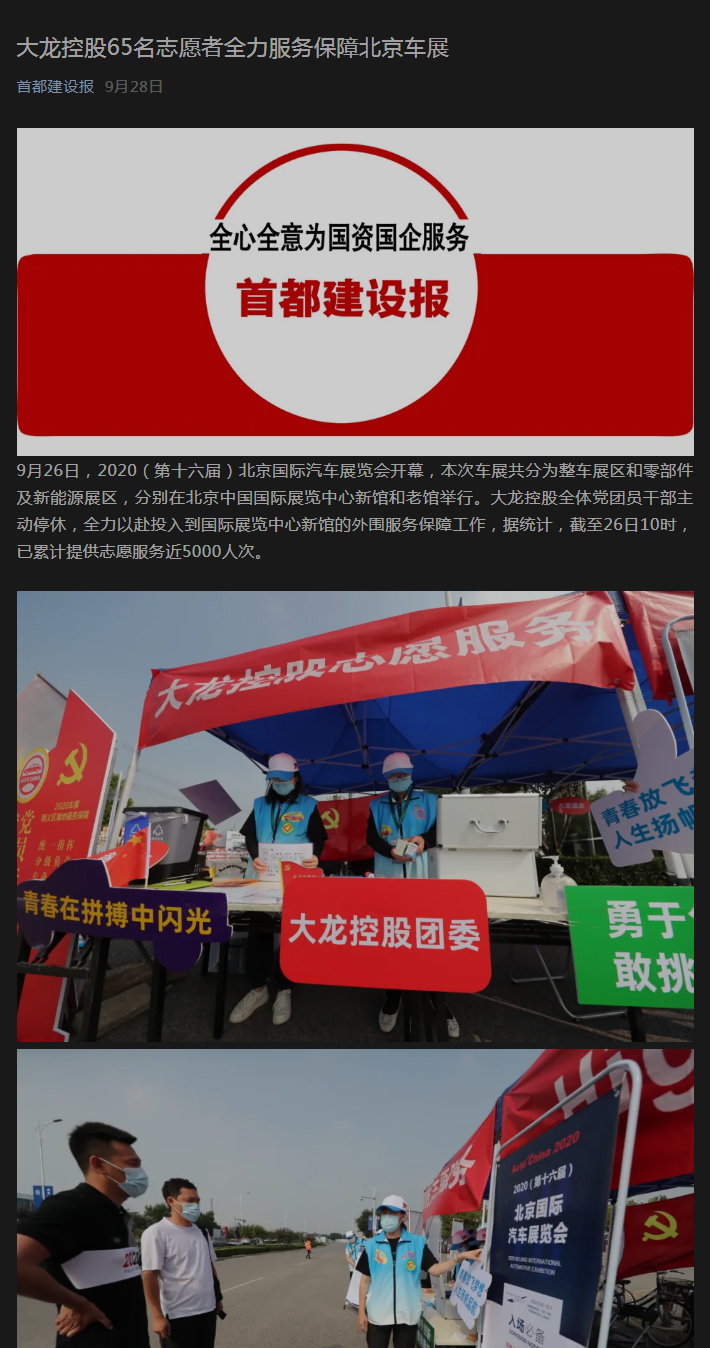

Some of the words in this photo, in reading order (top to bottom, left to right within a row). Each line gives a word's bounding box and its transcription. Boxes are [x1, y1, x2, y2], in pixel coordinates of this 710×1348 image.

[16, 36, 449, 59] 大龙控股65名志愿者全力服务保障北京车展
[16, 79, 94, 94] 首都建设报
[105, 79, 163, 94] 9月28日
[208, 221, 469, 253] 全心全意为国资国企服务
[237, 277, 449, 319] 首都建设报
[17, 463, 694, 480] 9月26日，2020（第十六届）北京国际汽车展览会开幕，本次车展共分为整车展区和零部件
[17, 490, 694, 506] 及新能源展区，分别在北京中国国际展览中心新馆和老馆举行。大龙控股全体党团员干部主
[17, 517, 687, 533] 动停休，全力以赴投入到国际展览中心新馆的外围服务保障工作，据统计，截至26日10时，
[17, 544, 262, 560] 已累计提供志愿服务近5000人次。
[601, 766, 694, 828] 青春放飞
[23, 890, 213, 936] 青春在拼搏中闪光
[606, 900, 694, 940] 勇于
[288, 913, 481, 953] 大龙控股团委
[528, 1148, 551, 1167] China
[553, 1130, 581, 1155] 2020
[514, 1193, 564, 1223] 北京国际
[508, 1222, 569, 1245] 汽车展览会
[508, 1313, 545, 1345] 入场必备
